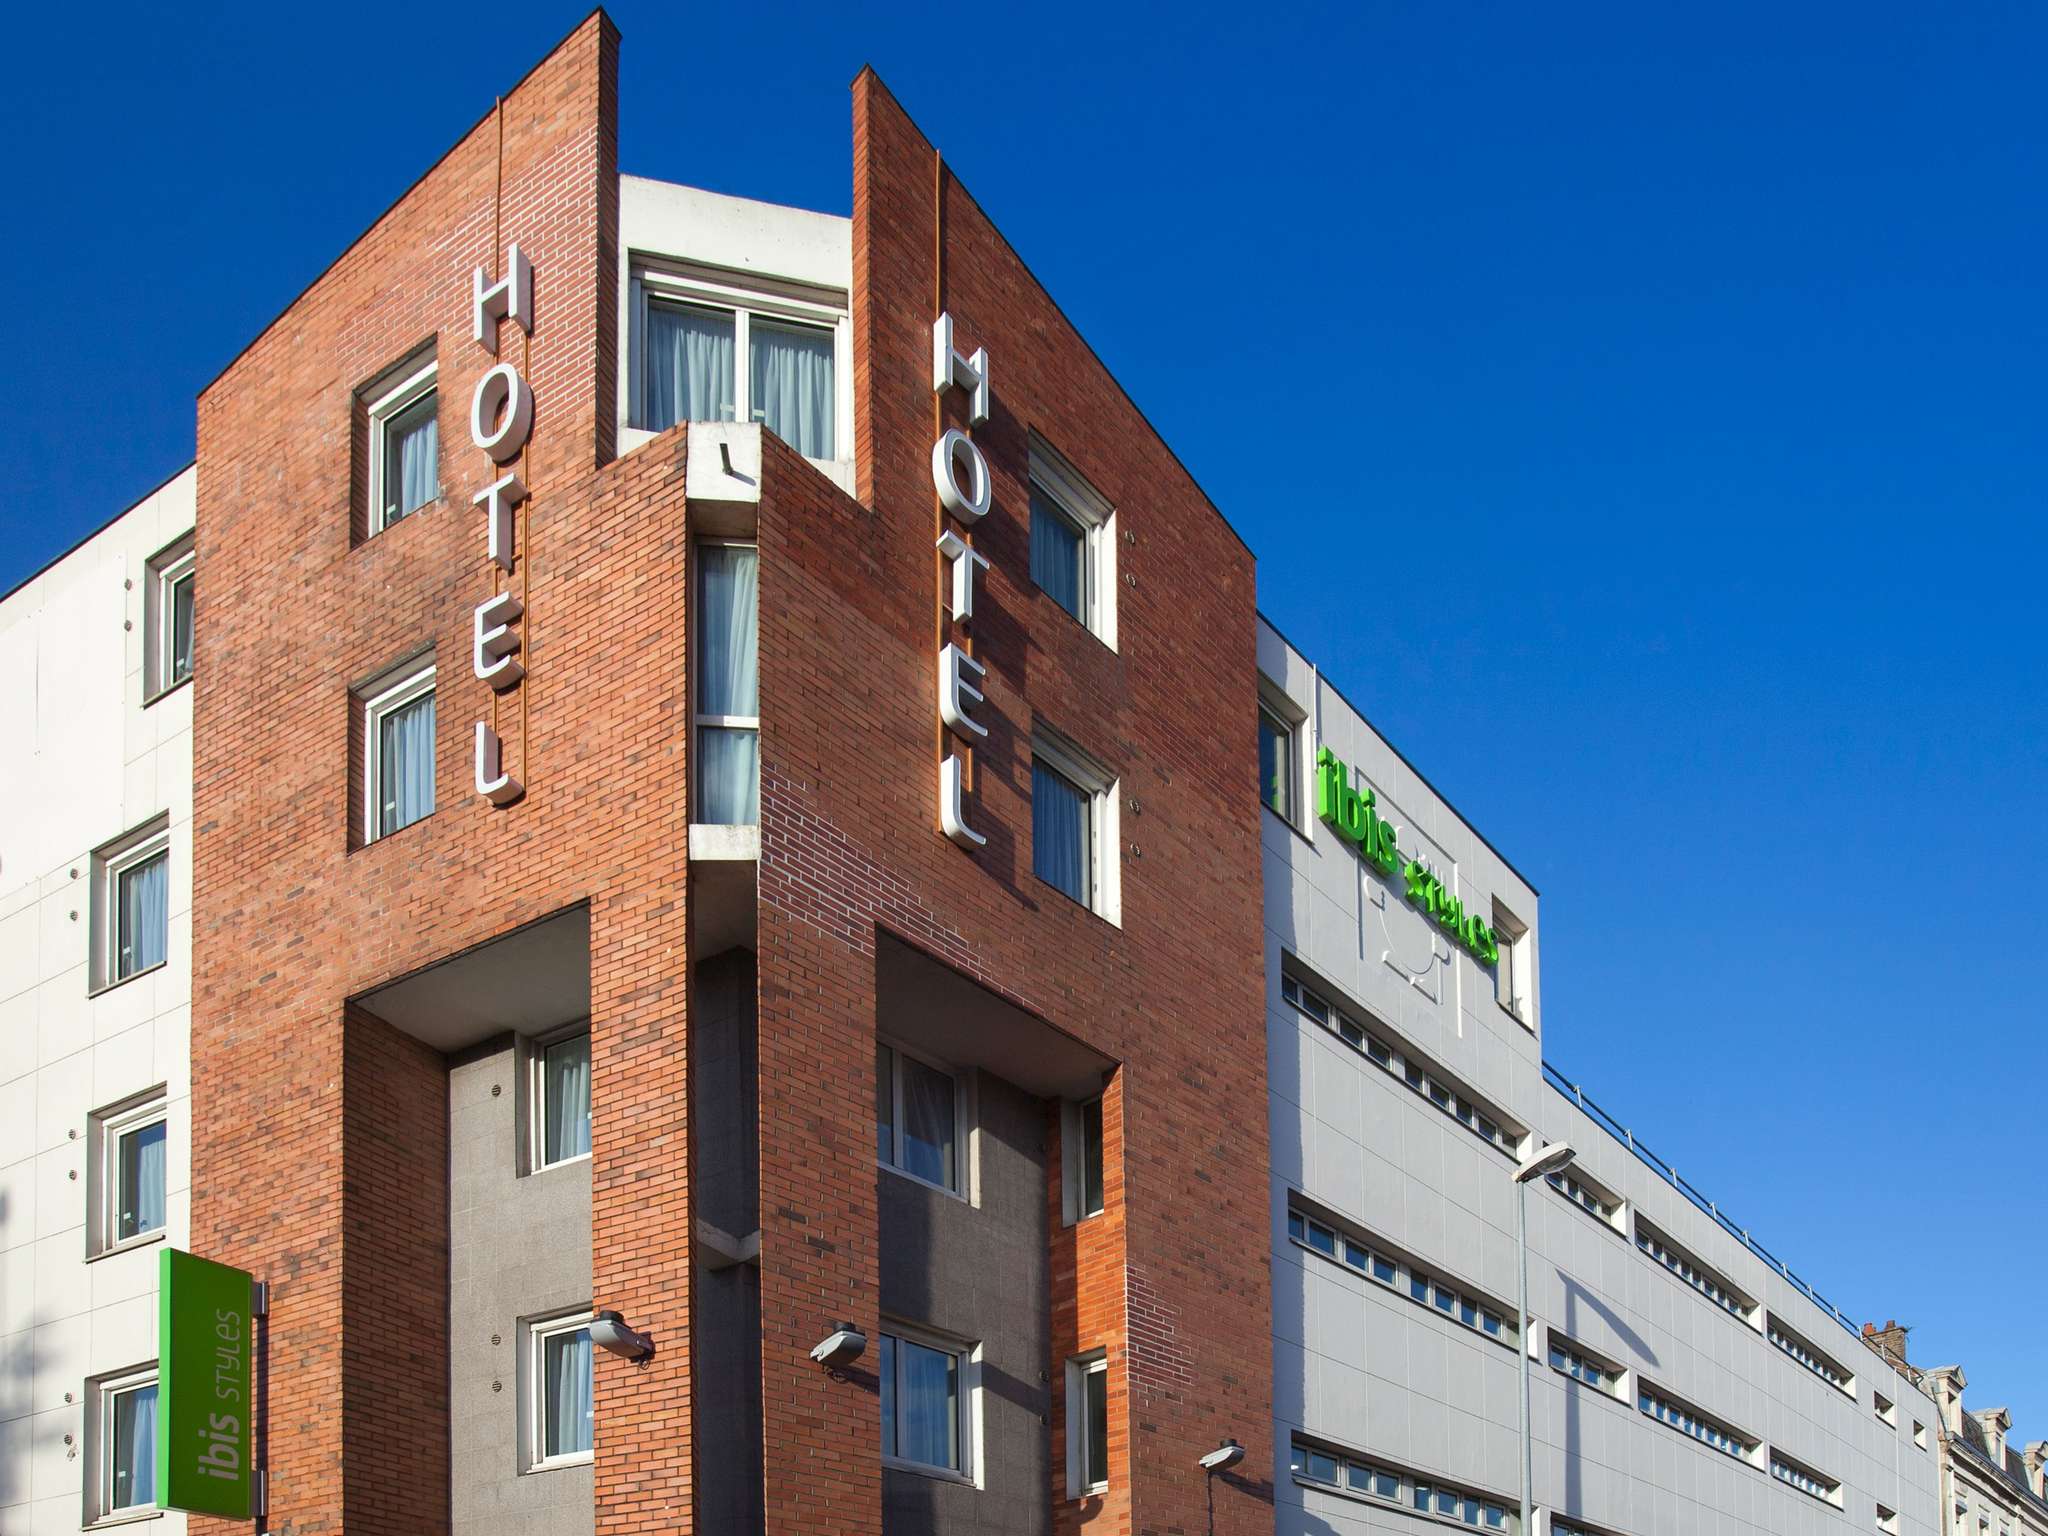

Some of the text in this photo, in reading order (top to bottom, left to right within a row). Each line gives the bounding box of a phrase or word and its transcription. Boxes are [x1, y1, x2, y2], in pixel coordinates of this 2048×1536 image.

[472, 242, 532, 807] HOTEL
[933, 311, 991, 851] HOTEL
[1317, 745, 1398, 876] ibis
[198, 1413, 240, 1481] ibis
